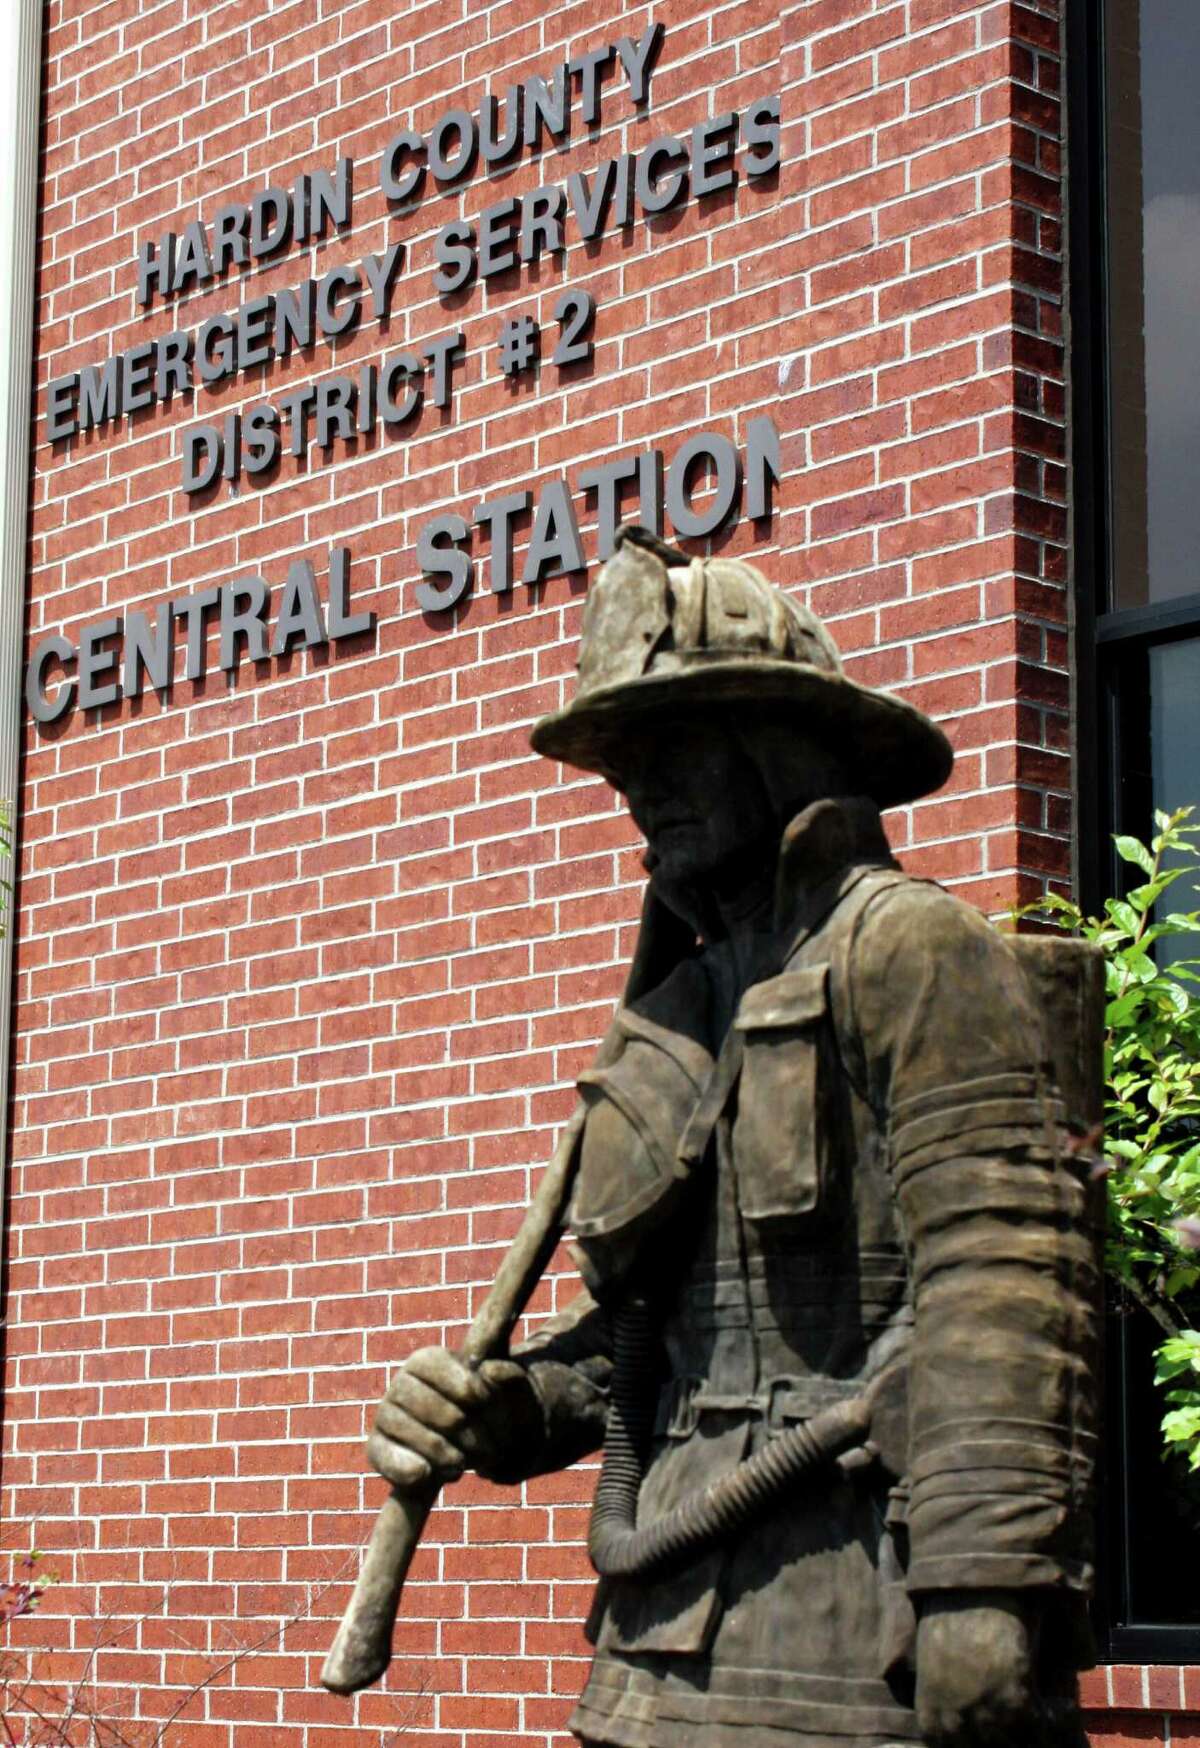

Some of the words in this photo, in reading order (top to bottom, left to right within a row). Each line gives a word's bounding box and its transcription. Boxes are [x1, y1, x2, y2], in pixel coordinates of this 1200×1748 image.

[46, 244, 405, 442] EMERGENCY
[432, 96, 780, 294] SERVICES
[138, 157, 354, 304] HARDIN
[380, 23, 664, 201] COUNTY
[182, 334, 463, 493] DISTRICT
[26, 548, 377, 722] CENTRAL
